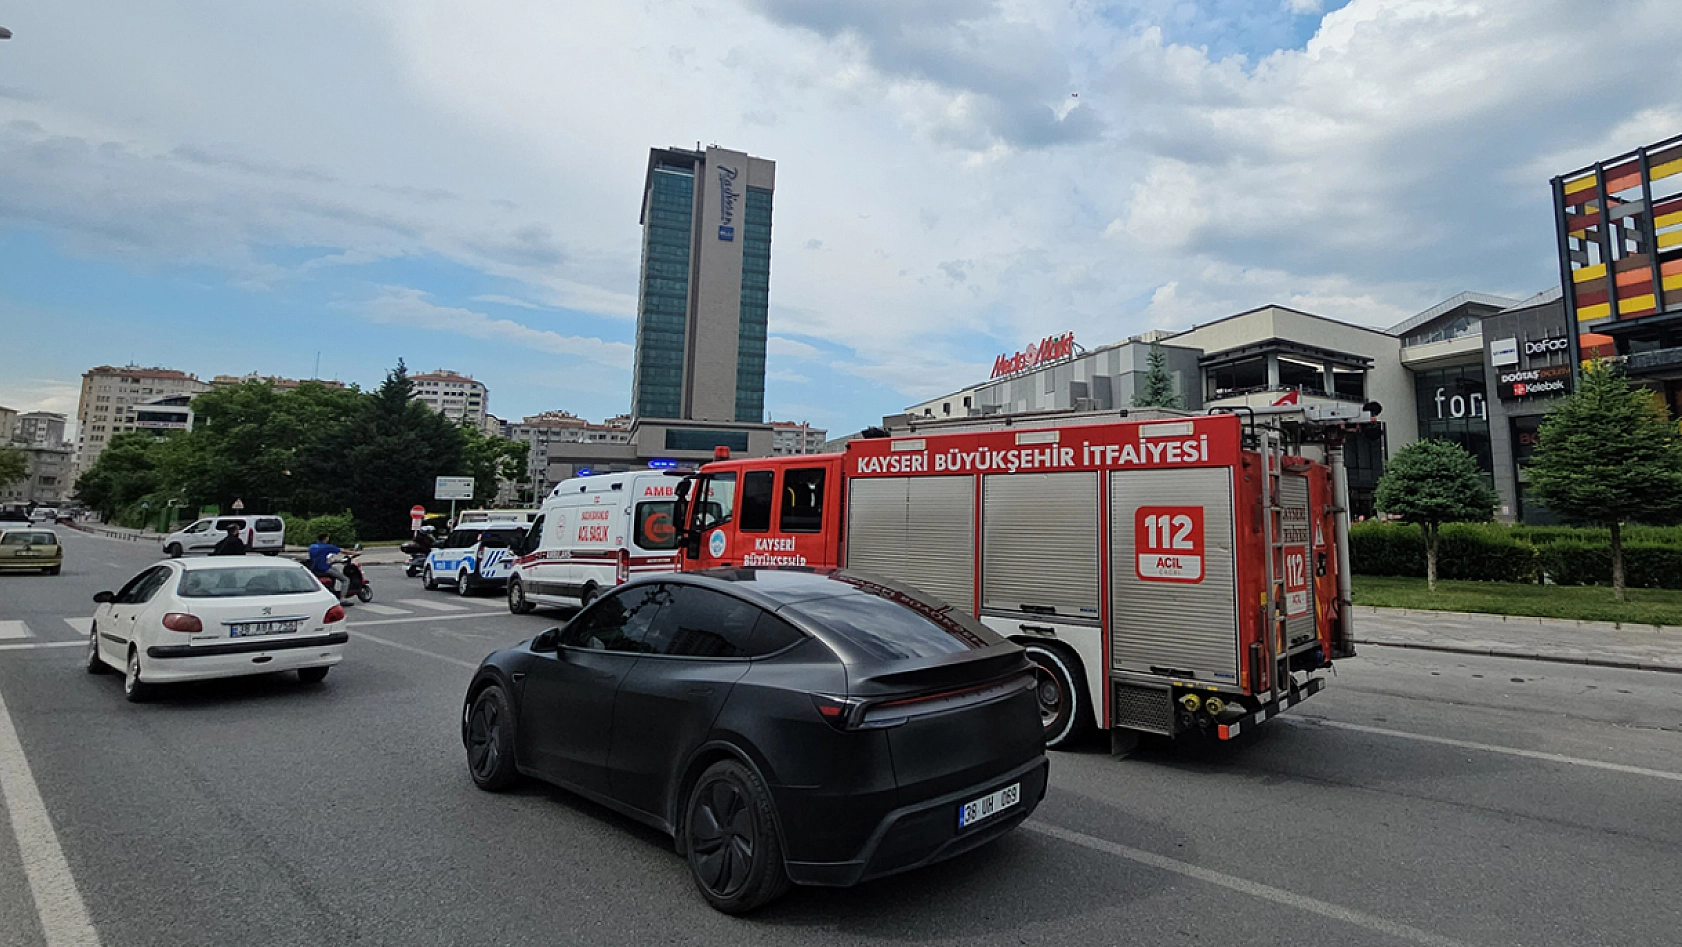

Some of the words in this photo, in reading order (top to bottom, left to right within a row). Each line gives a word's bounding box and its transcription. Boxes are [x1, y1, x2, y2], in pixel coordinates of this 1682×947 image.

[1525, 338, 1568, 354] DeFac
[1526, 379, 1565, 393] Kelebek
[857, 450, 929, 473] KAYSERİ
[934, 443, 1075, 473] BÜYÜKŞEHİR
[1083, 435, 1208, 466] İTFAİYESİ
[1144, 514, 1194, 549] 112
[755, 536, 796, 551] KAYSERİ
[1156, 557, 1183, 570] ACİL
[1287, 554, 1304, 587] 112
[965, 803, 977, 823] 38
[981, 795, 994, 815] UH
